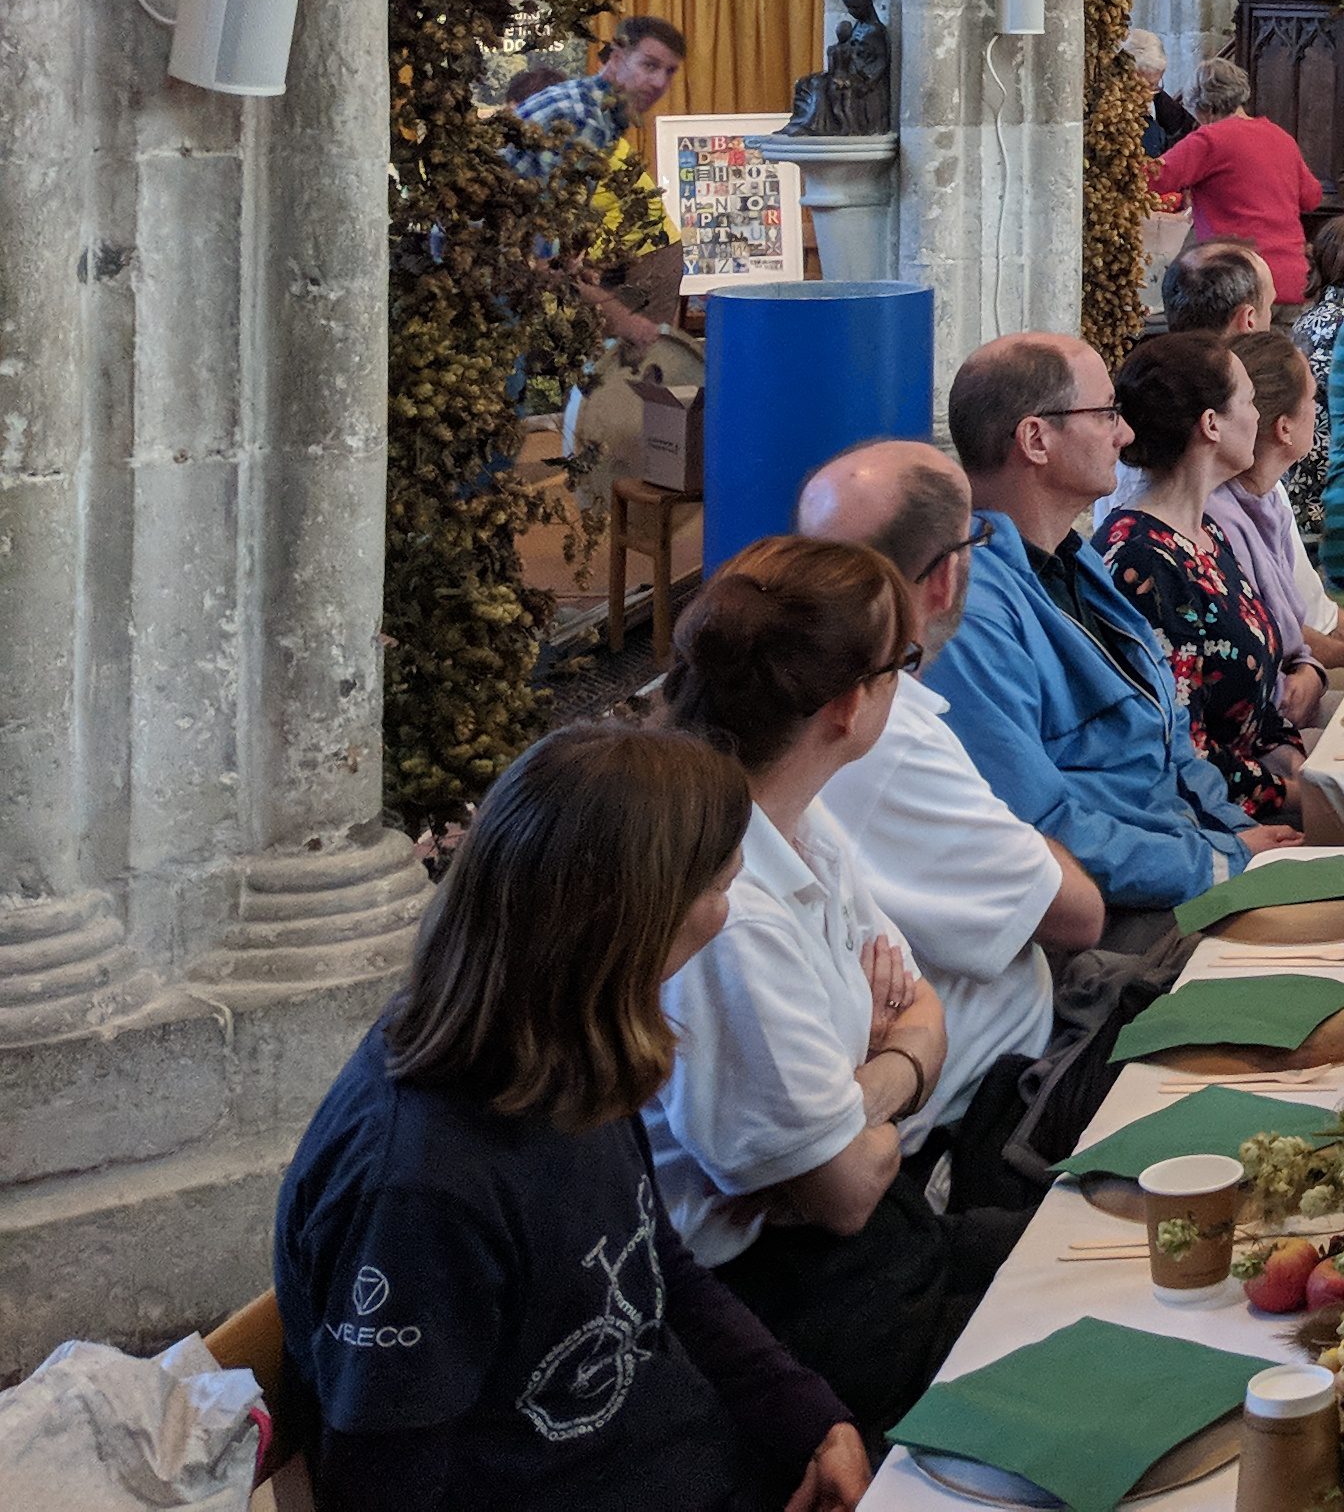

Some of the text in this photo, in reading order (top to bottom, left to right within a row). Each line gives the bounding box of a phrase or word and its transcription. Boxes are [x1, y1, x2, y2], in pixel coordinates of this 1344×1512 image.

[679, 137, 692, 150] A
[714, 136, 727, 150] B
[715, 166, 728, 182] H
[731, 182, 746, 195] K
[681, 197, 696, 213] M
[715, 197, 730, 213] N
[700, 209, 780, 227] P R
[714, 227, 731, 243] T
